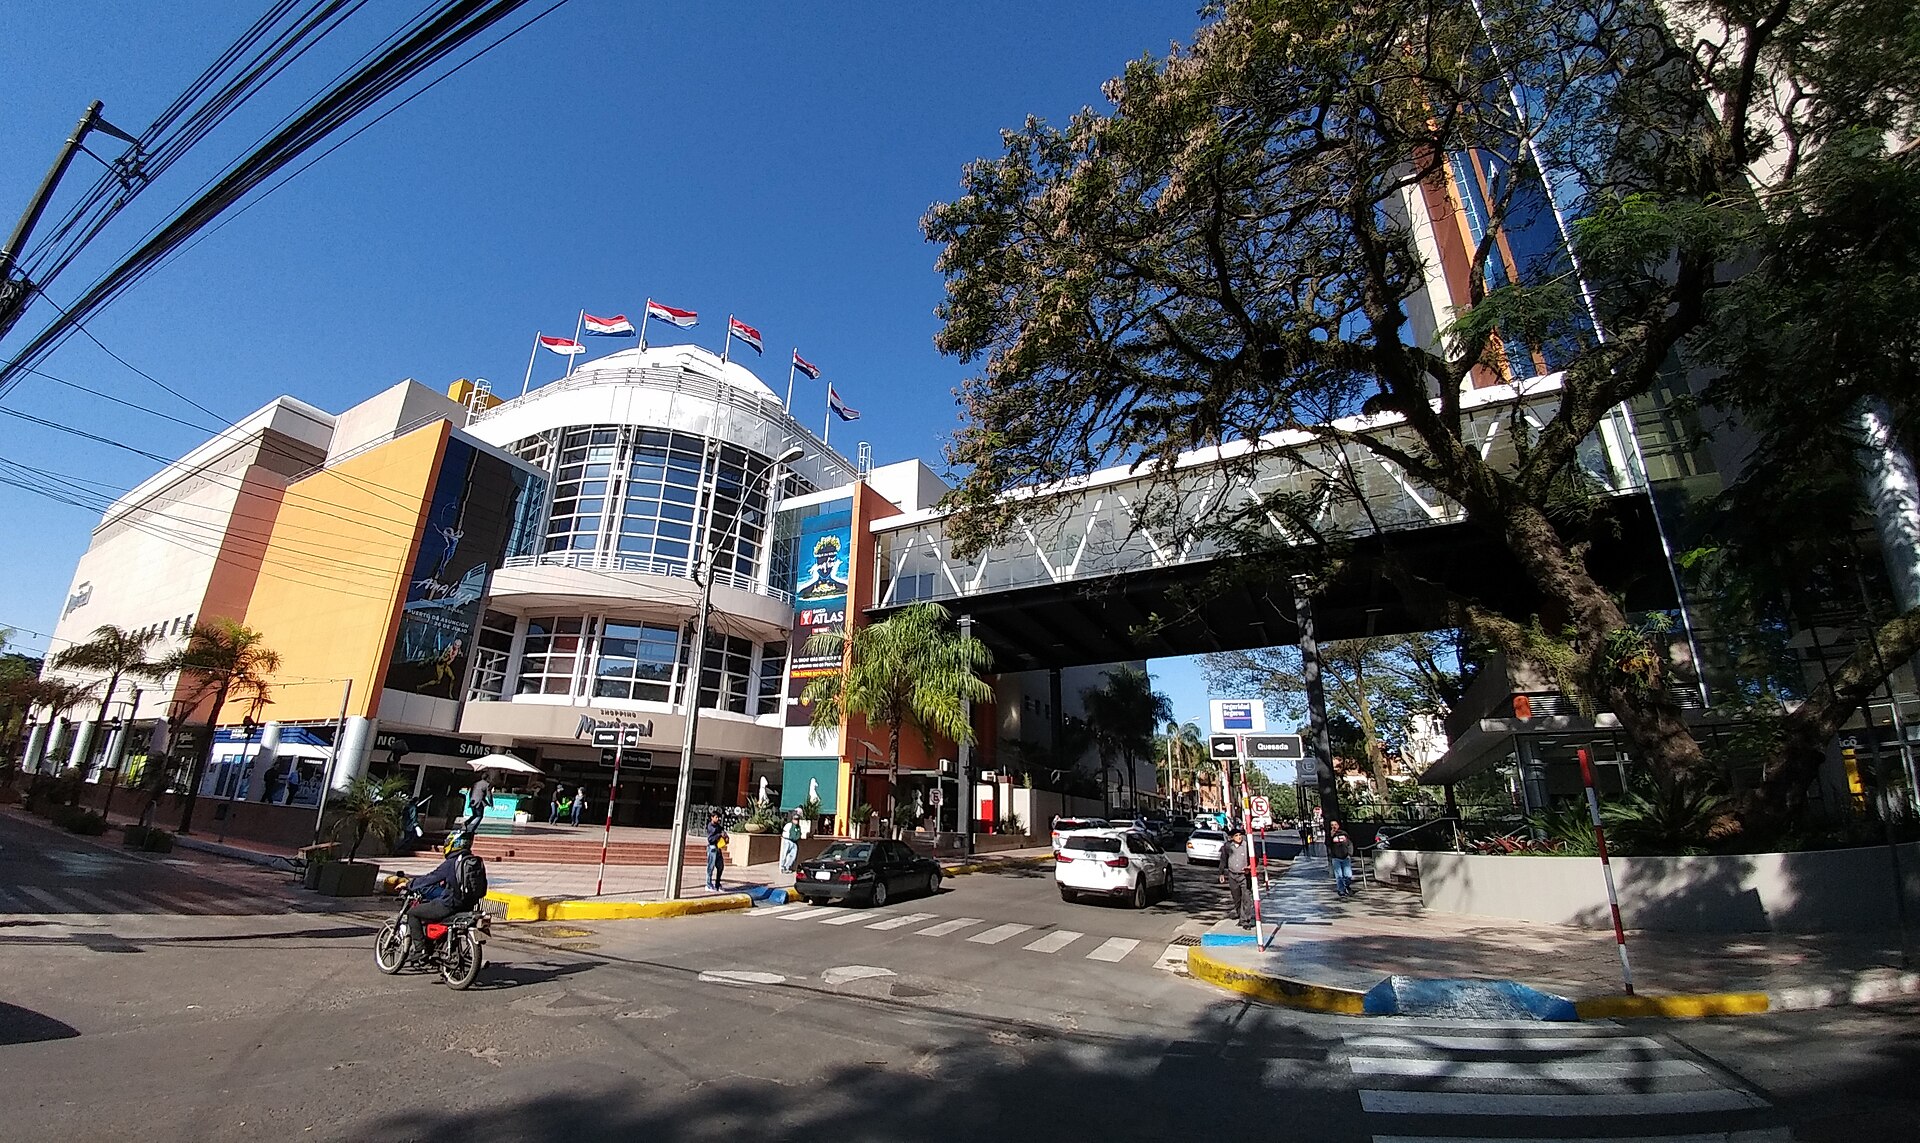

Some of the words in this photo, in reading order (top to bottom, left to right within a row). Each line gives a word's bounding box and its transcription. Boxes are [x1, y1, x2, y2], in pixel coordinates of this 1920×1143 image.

[812, 610, 844, 625] ATLAS
[600, 708, 637, 719] SHOPPING
[1257, 743, 1289, 751] Quesada
